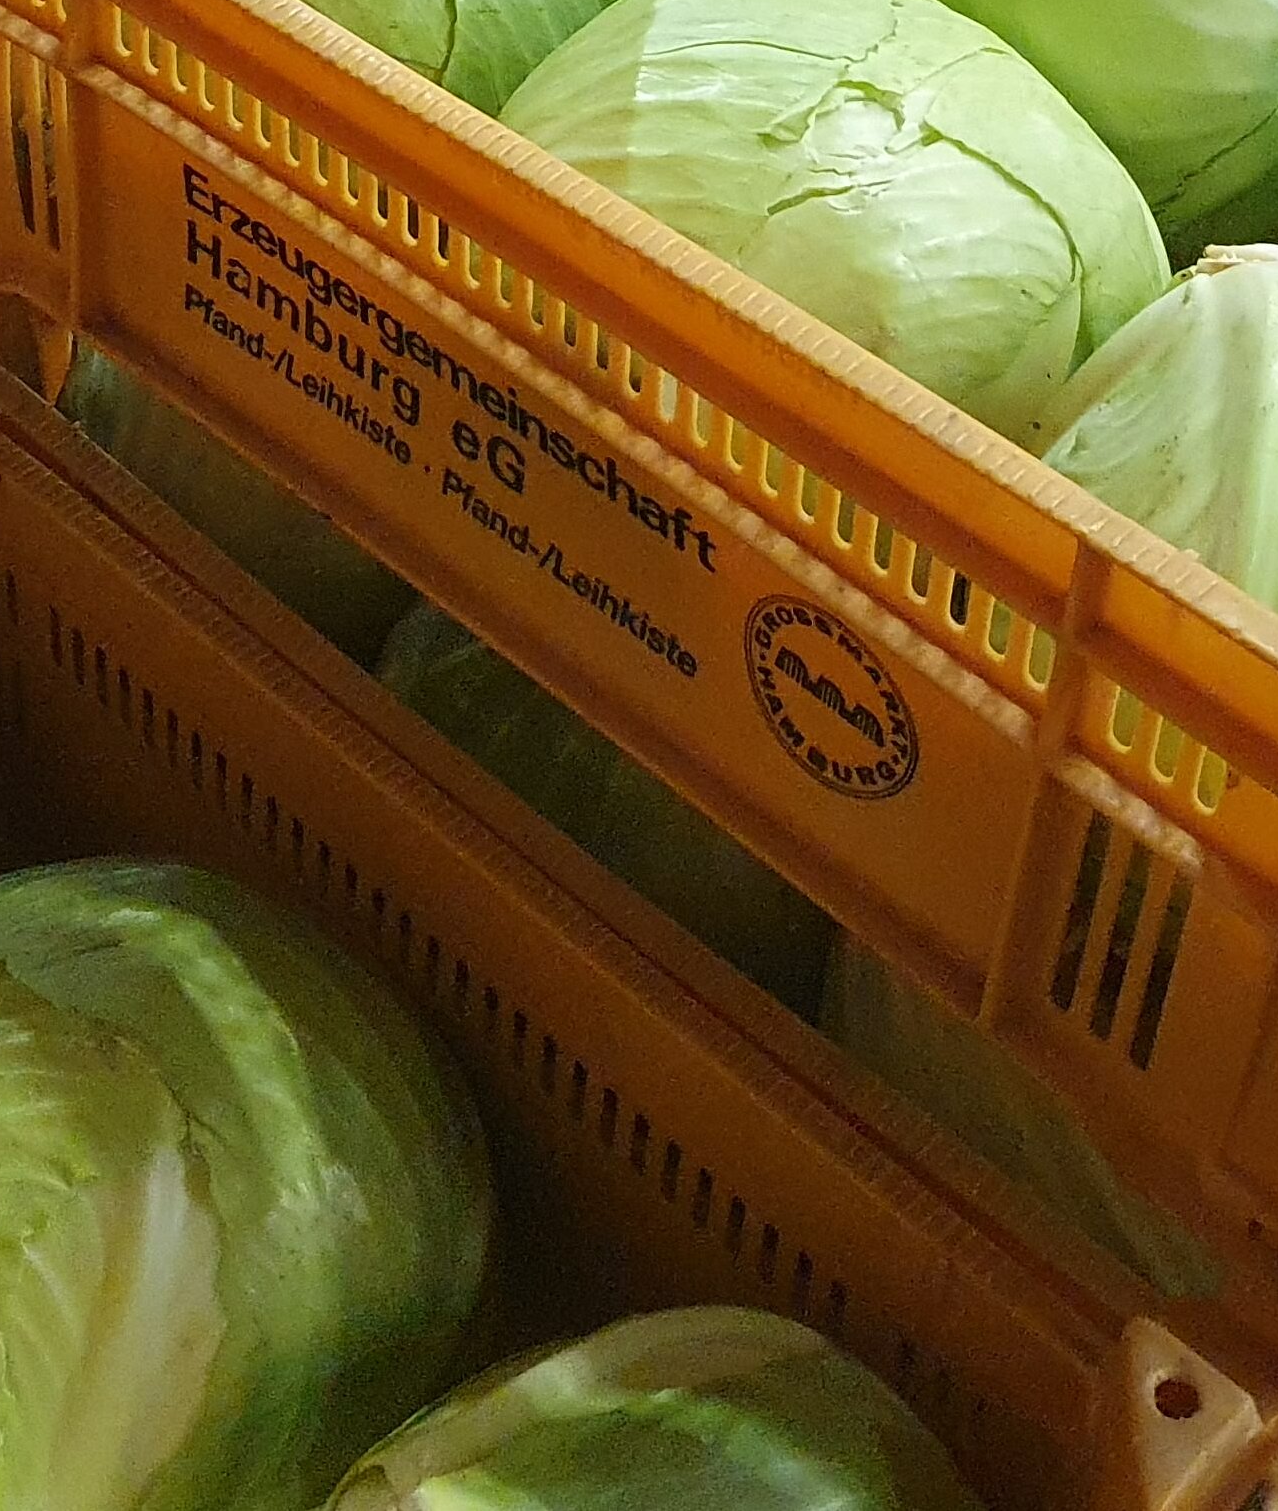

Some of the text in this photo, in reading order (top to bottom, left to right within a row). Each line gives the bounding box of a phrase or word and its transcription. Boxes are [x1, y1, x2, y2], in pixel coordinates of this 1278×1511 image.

[183, 162, 717, 574] Erzeugergemeinschaft
[185, 282, 699, 679] Pfand-/Leihkiste Pfand-/Leihkiste
[187, 219, 526, 495] Hamburg eG
[754, 604, 909, 760] GROSSMARKT
[756, 665, 898, 786] HAMBURG
